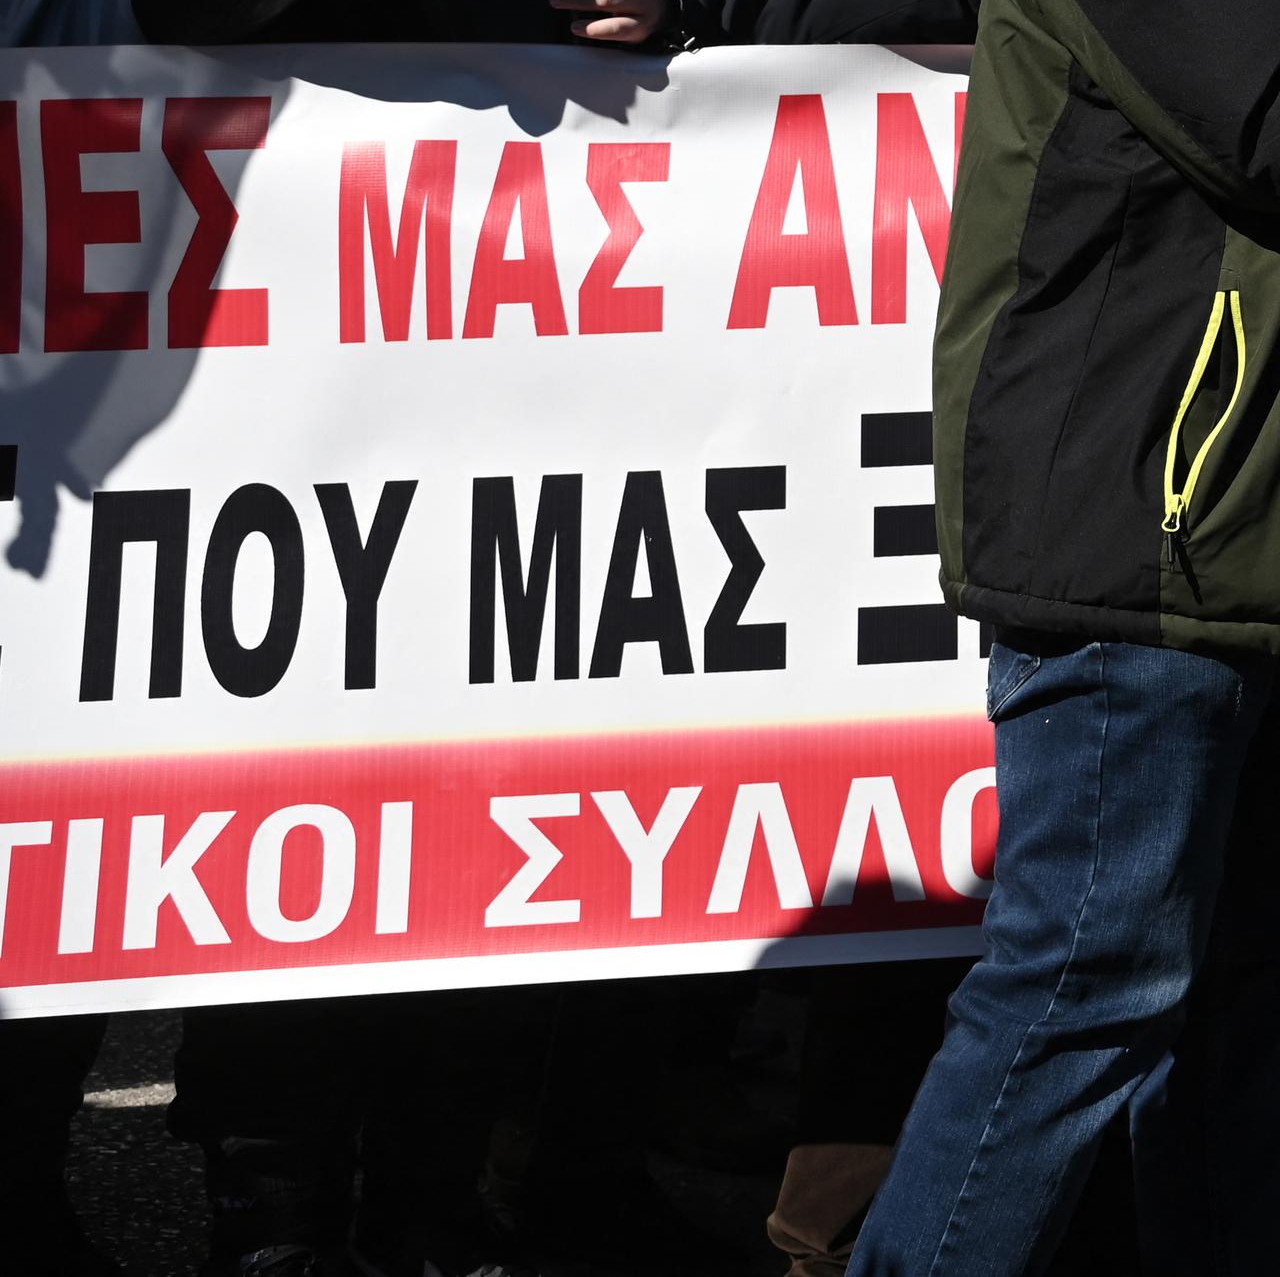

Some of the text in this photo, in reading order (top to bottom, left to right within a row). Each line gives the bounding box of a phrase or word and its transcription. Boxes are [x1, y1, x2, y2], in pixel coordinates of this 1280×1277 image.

[338, 140, 670, 344] ΜΑΣ
[79, 479, 419, 703] ΠΟΥ
[468, 465, 787, 685] ΜΑΣ
